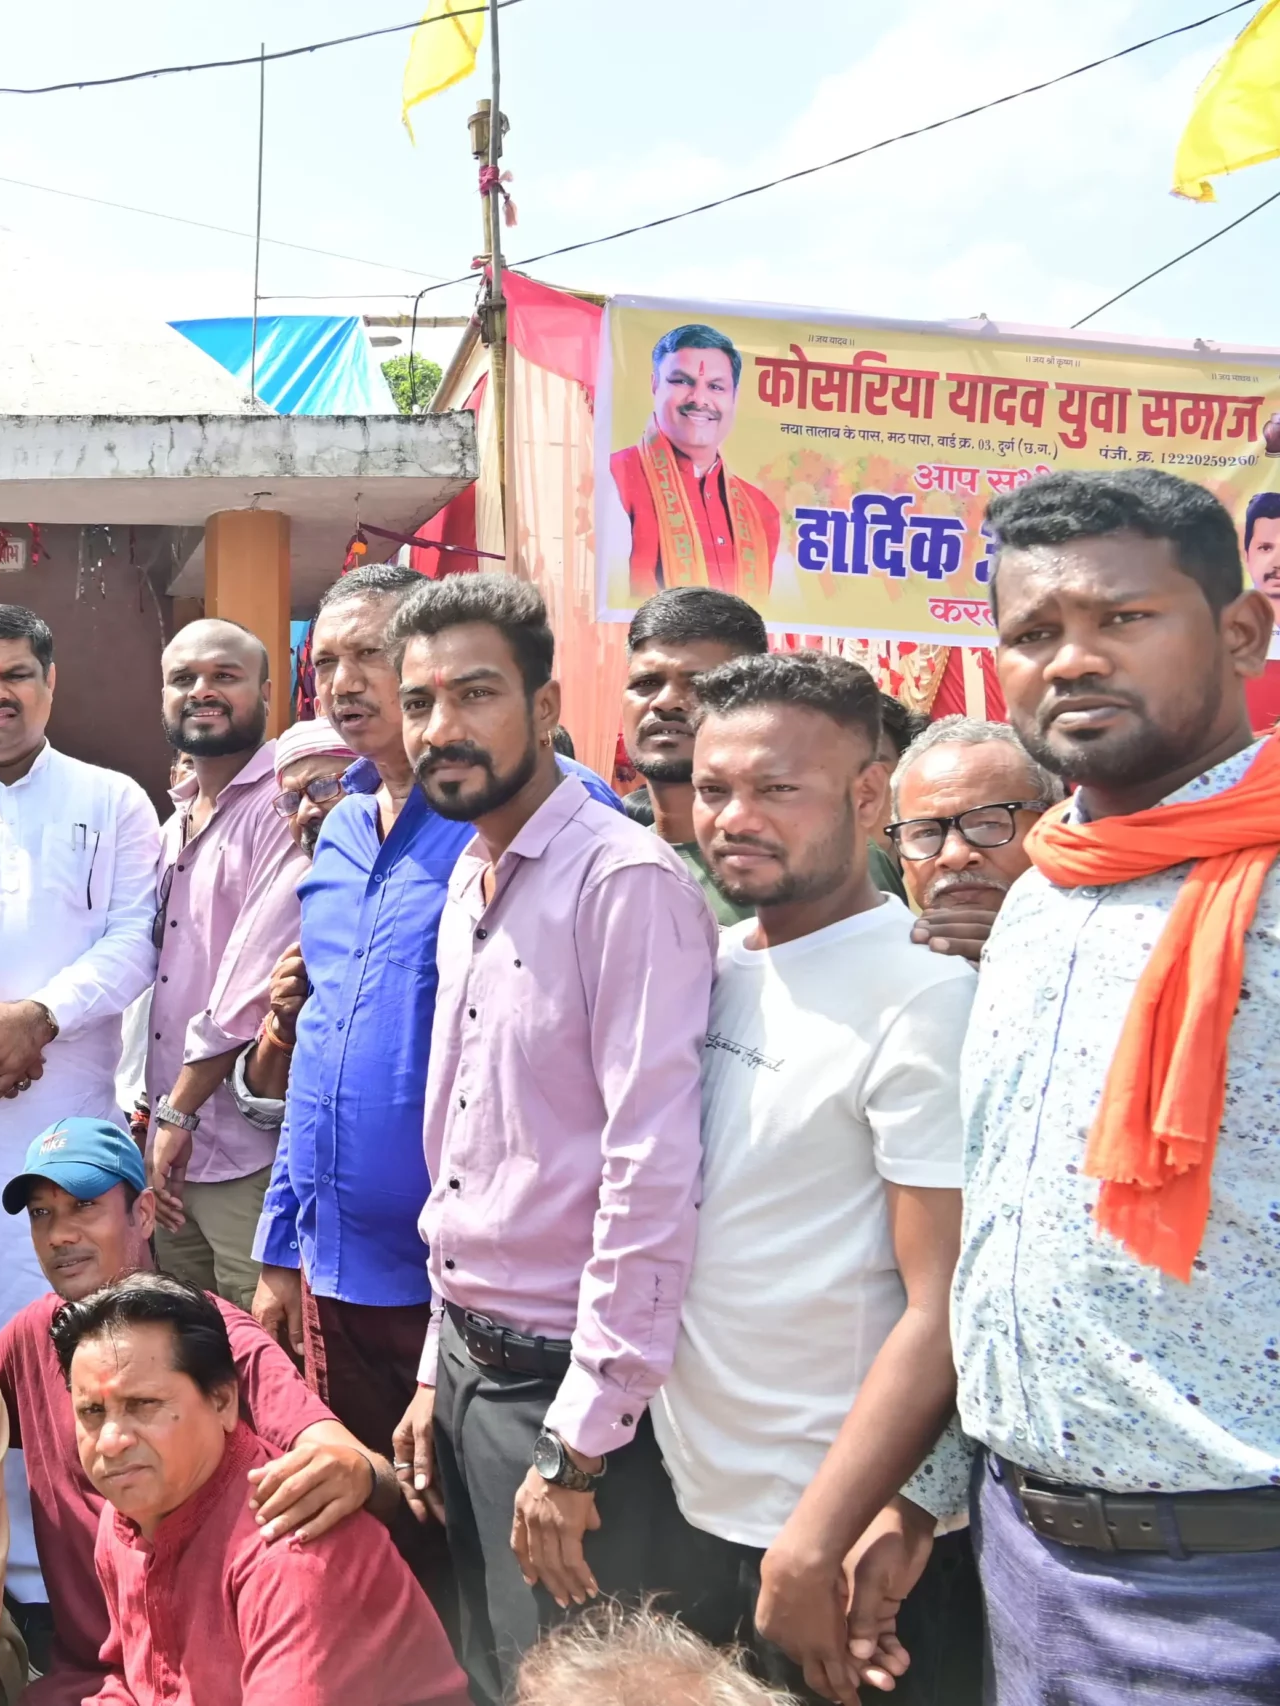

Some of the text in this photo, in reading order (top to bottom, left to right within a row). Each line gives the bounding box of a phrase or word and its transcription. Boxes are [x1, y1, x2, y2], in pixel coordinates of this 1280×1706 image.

[829, 336, 848, 346] यादव
[755, 344, 1266, 449] कोसरिया यादव युवा समाज
[780, 423, 803, 436] नया
[805, 425, 841, 439] तालाब
[843, 424, 856, 440] के
[858, 429, 884, 443] पास,
[887, 431, 906, 444] मठ
[908, 433, 934, 447] पारा,
[937, 432, 956, 448] वार्ड
[959, 437, 975, 450] क्र.
[978, 438, 995, 452] 03,
[998, 437, 1015, 457] दुर्ग
[1099, 444, 1132, 461] पंजी.
[1136, 450, 1155, 463] क्र.
[914, 465, 980, 493] आप
[795, 494, 965, 580] हार्दिक
[39, 1138, 68, 1156] NIKE
